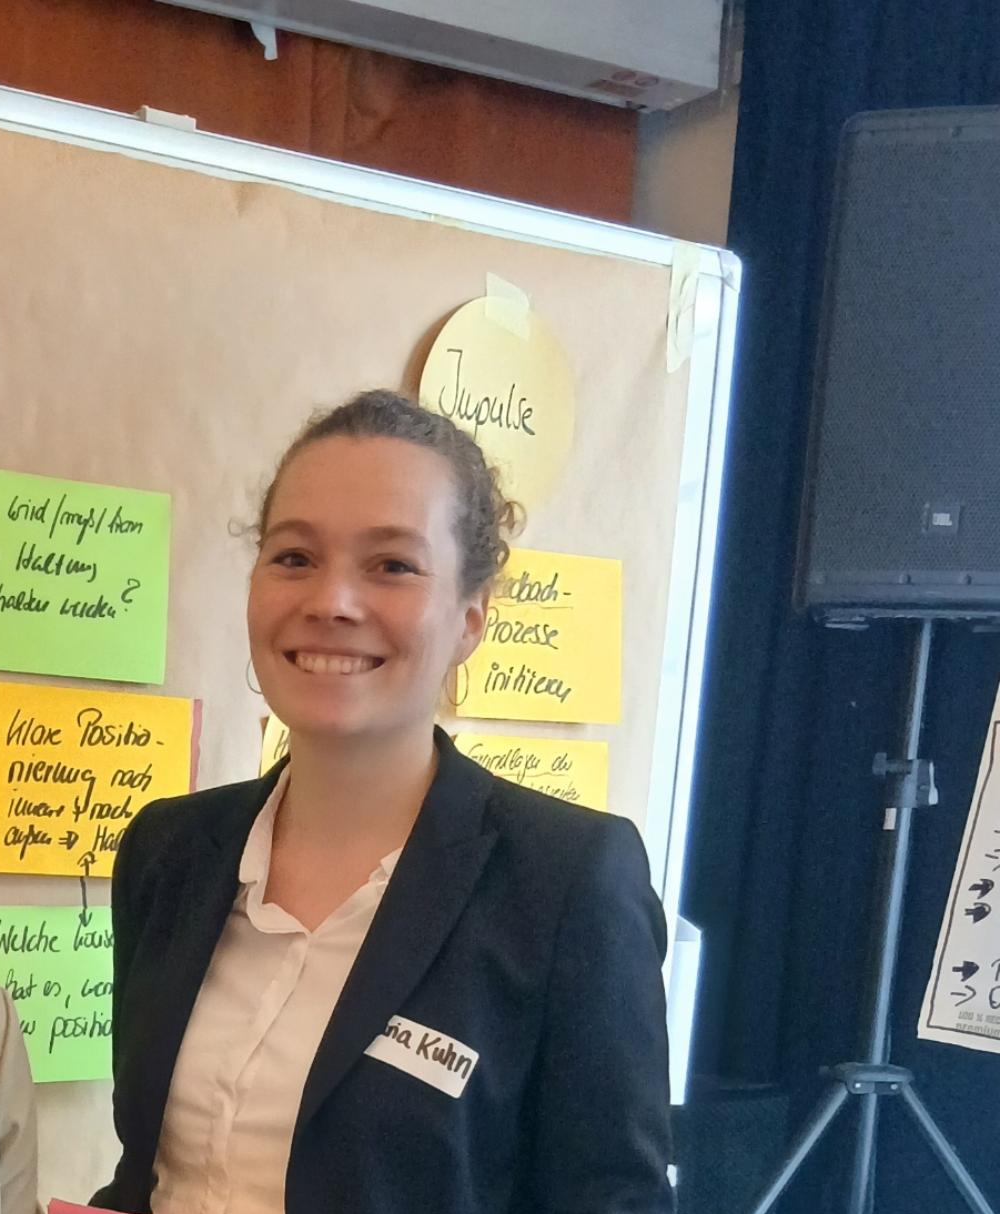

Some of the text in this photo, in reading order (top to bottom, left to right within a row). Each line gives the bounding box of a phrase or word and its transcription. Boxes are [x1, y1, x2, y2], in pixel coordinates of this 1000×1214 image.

[16, 541, 97, 583] Haltung
[483, 606, 559, 650] Prozesse
[6, 709, 62, 747] Klare
[8, 753, 152, 814] nierung nach
[89, 796, 133, 820] nach
[4, 824, 51, 860] außen
[415, 1032, 473, 1080] Kuhn
